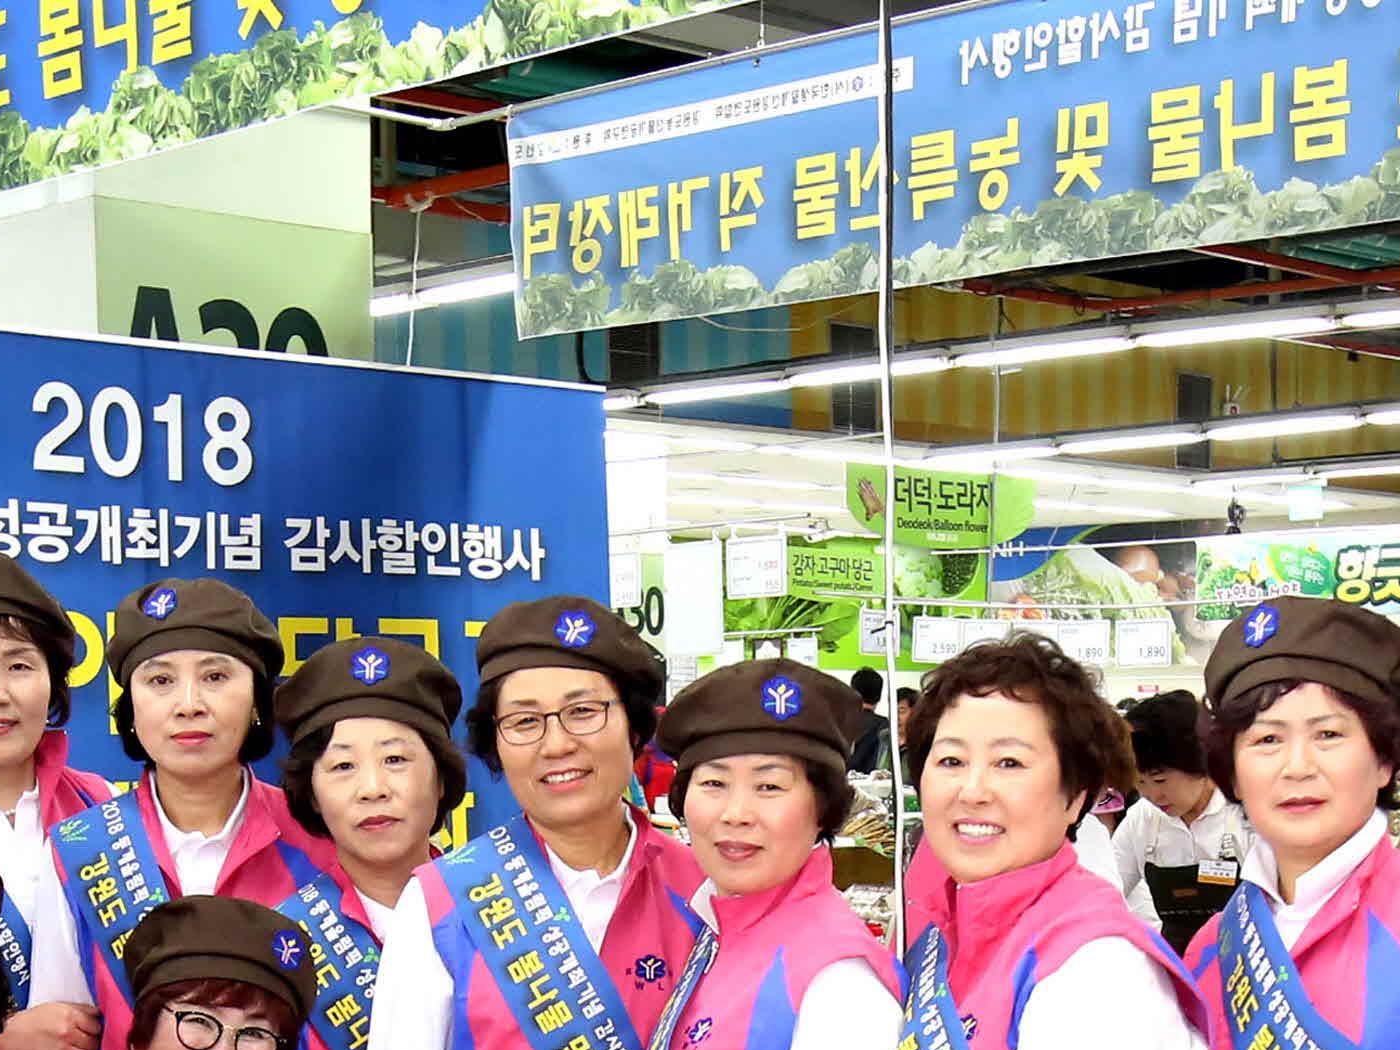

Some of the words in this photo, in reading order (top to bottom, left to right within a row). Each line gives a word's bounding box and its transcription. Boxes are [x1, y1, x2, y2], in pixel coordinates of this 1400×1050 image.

[31, 381, 255, 486] 2018
[283, 514, 546, 582] 감사할인행사
[620, 586, 665, 636] 30
[101, 800, 120, 835] 2018
[79, 852, 128, 928] 강원도
[106, 836, 151, 905] 동계올림픽
[309, 899, 364, 969] 동계올림픽
[468, 872, 528, 951] 강원도
[506, 949, 575, 1037] 봄나물
[503, 854, 555, 923] 동계올림픽
[539, 922, 607, 1021] 성공개최기념
[1226, 953, 1260, 1033] 강원도
